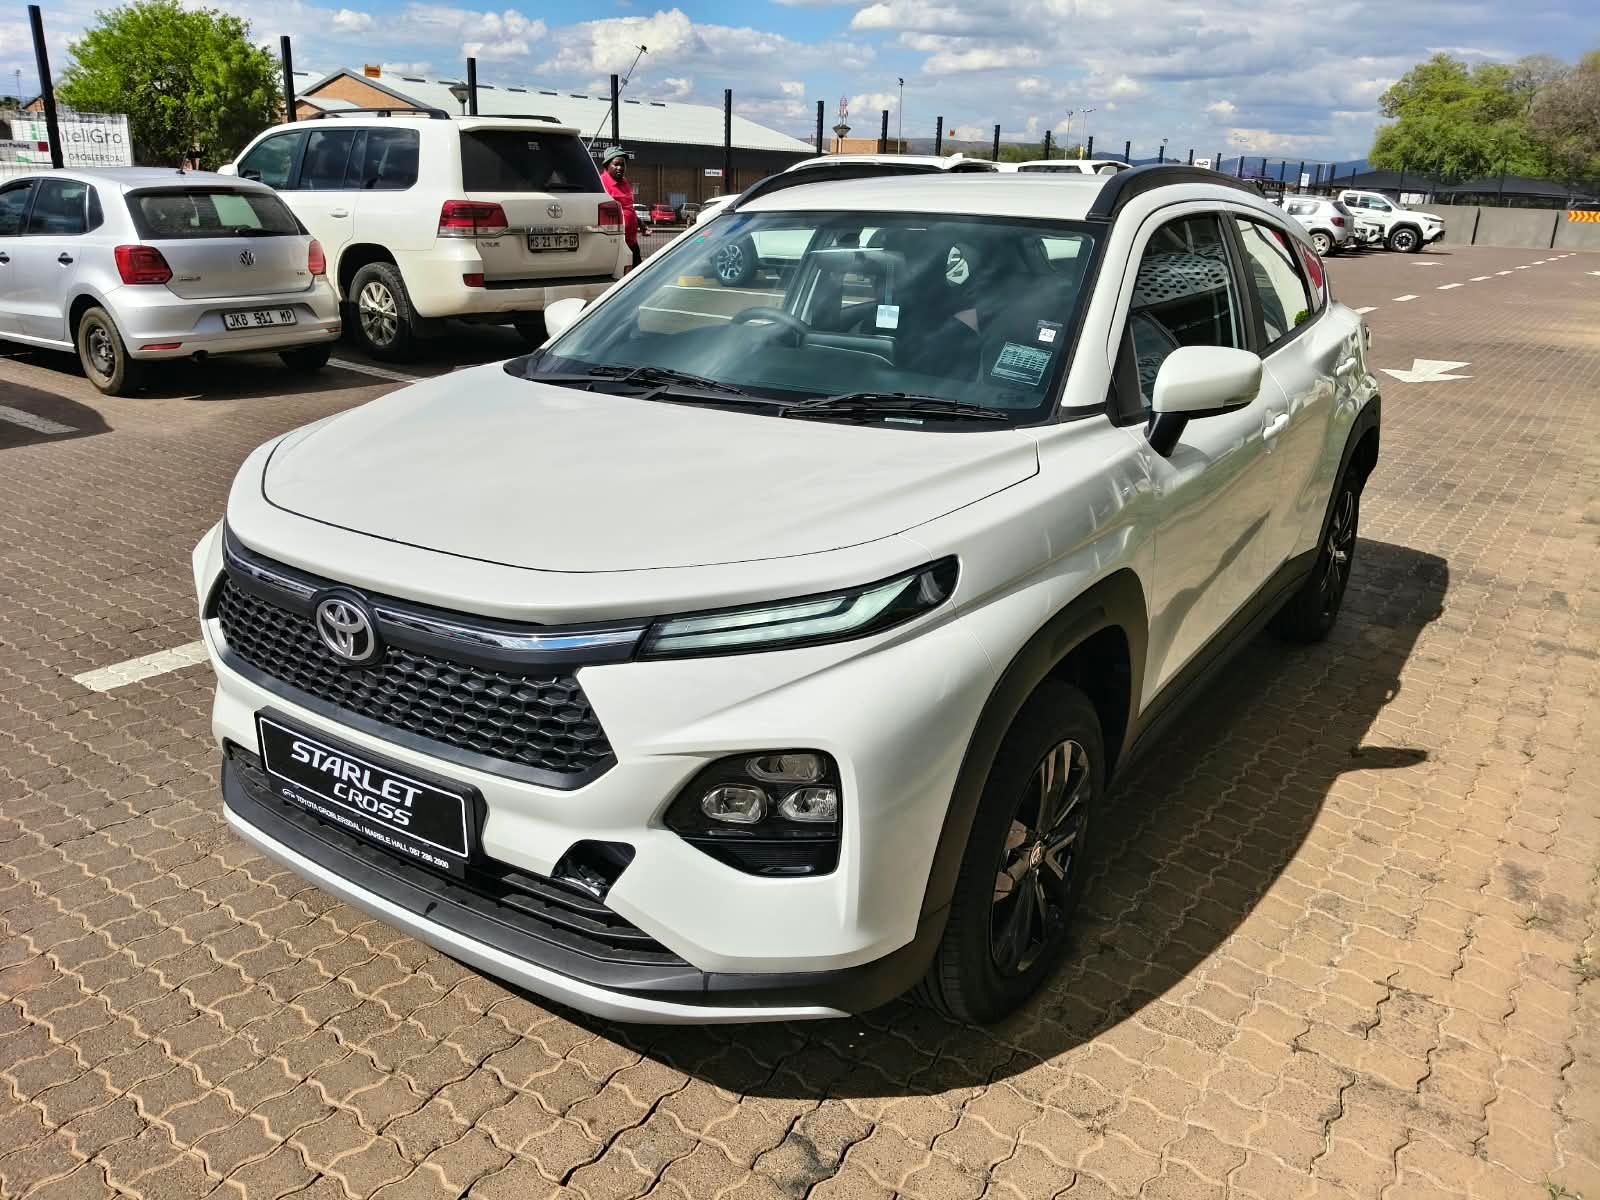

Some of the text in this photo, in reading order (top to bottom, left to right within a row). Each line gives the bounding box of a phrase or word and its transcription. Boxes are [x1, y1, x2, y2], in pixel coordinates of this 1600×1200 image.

[543, 236, 551, 247] 21
[569, 235, 577, 246] GP
[229, 310, 293, 327] JKB 511 MP
[290, 740, 423, 808] STARLET
[295, 794, 319, 812] TOYOTA
[317, 806, 361, 832] GROBLERSDAL
[364, 826, 392, 845] MARBLE
[391, 838, 409, 852] HALL
[333, 782, 413, 826] CROSS
